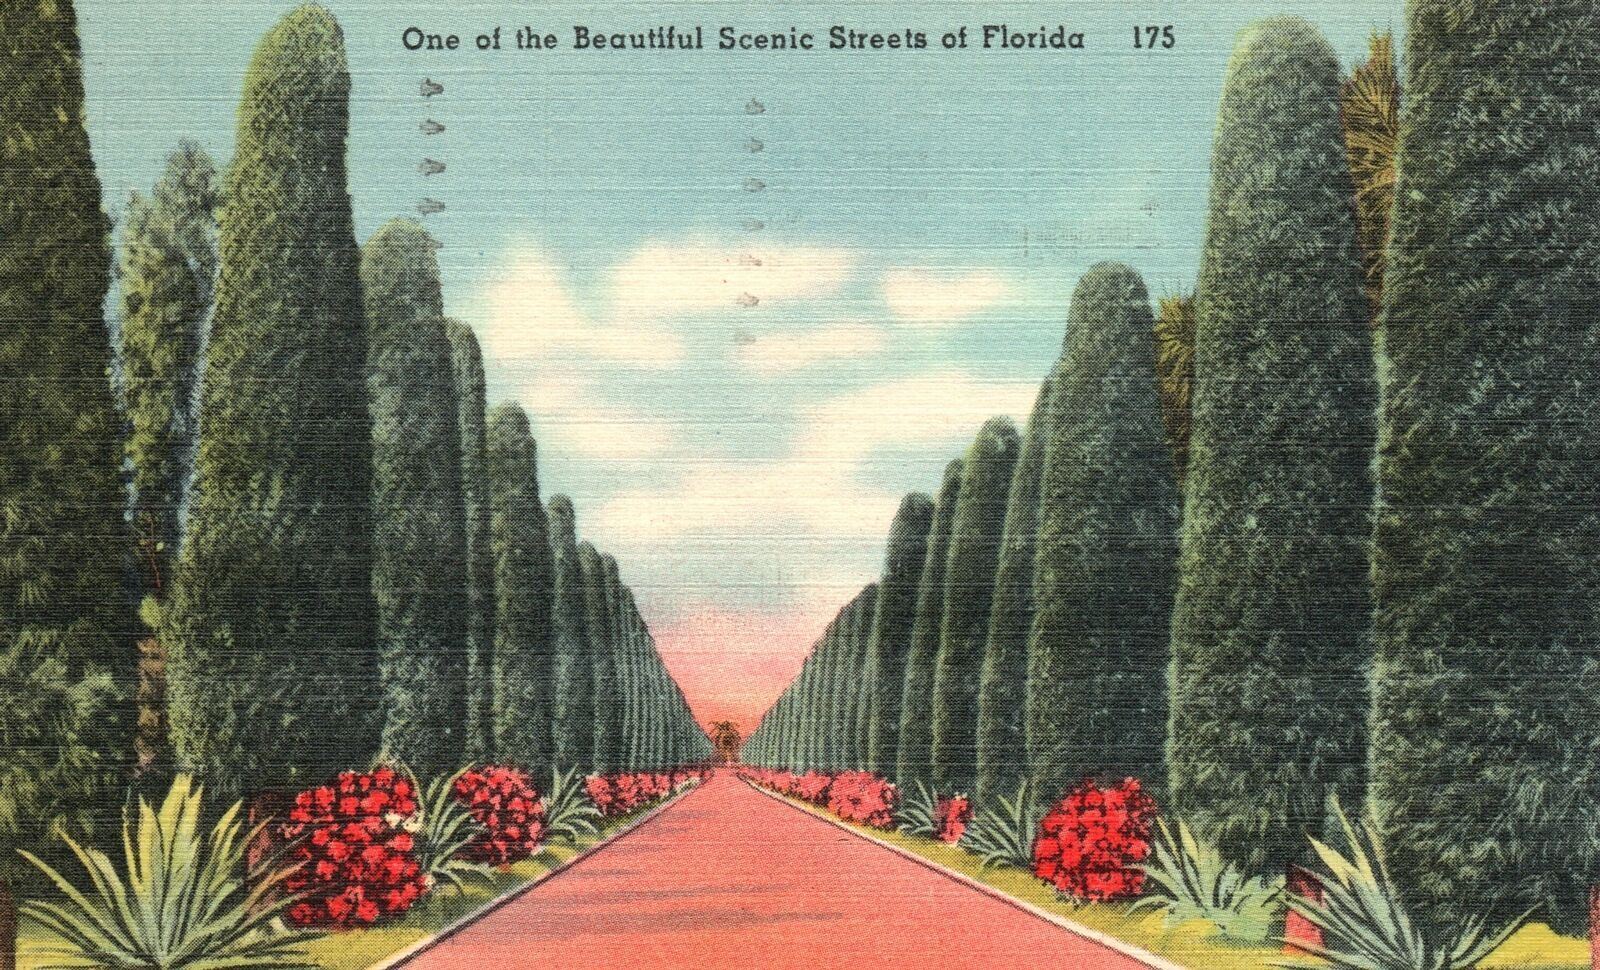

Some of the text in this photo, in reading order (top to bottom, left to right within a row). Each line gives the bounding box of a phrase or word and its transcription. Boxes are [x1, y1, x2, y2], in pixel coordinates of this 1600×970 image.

[402, 25, 1176, 51] One of the Beautiful Scenic Streets of Florida 175
